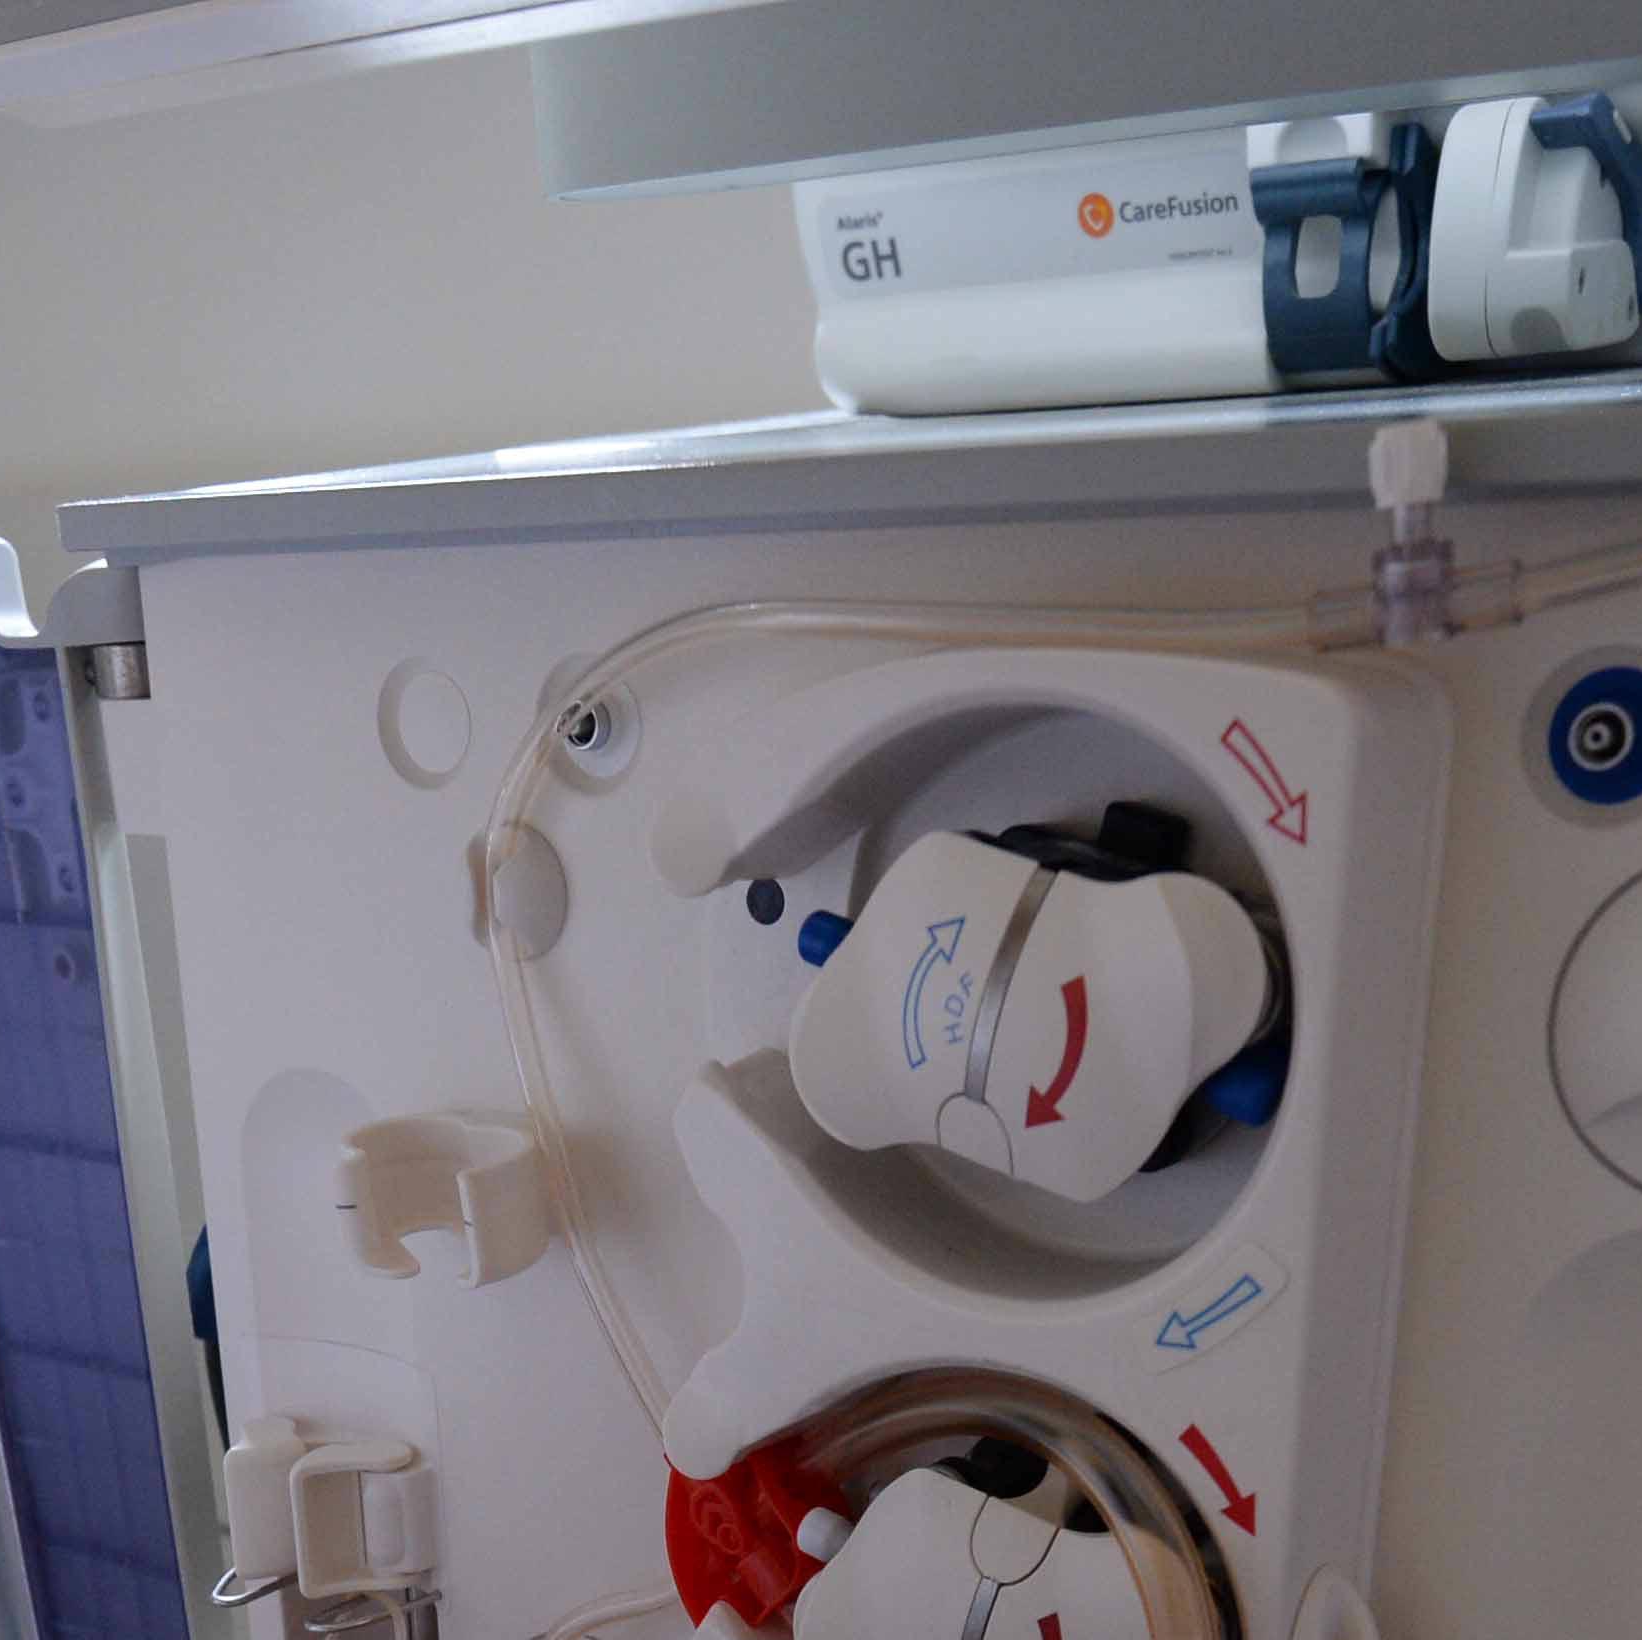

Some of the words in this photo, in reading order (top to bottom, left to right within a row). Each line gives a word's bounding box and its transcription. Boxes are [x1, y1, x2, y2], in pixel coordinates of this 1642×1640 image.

[1119, 191, 1239, 224] CareFusion
[842, 236, 902, 282] GH
[943, 970, 974, 1045] HDF
